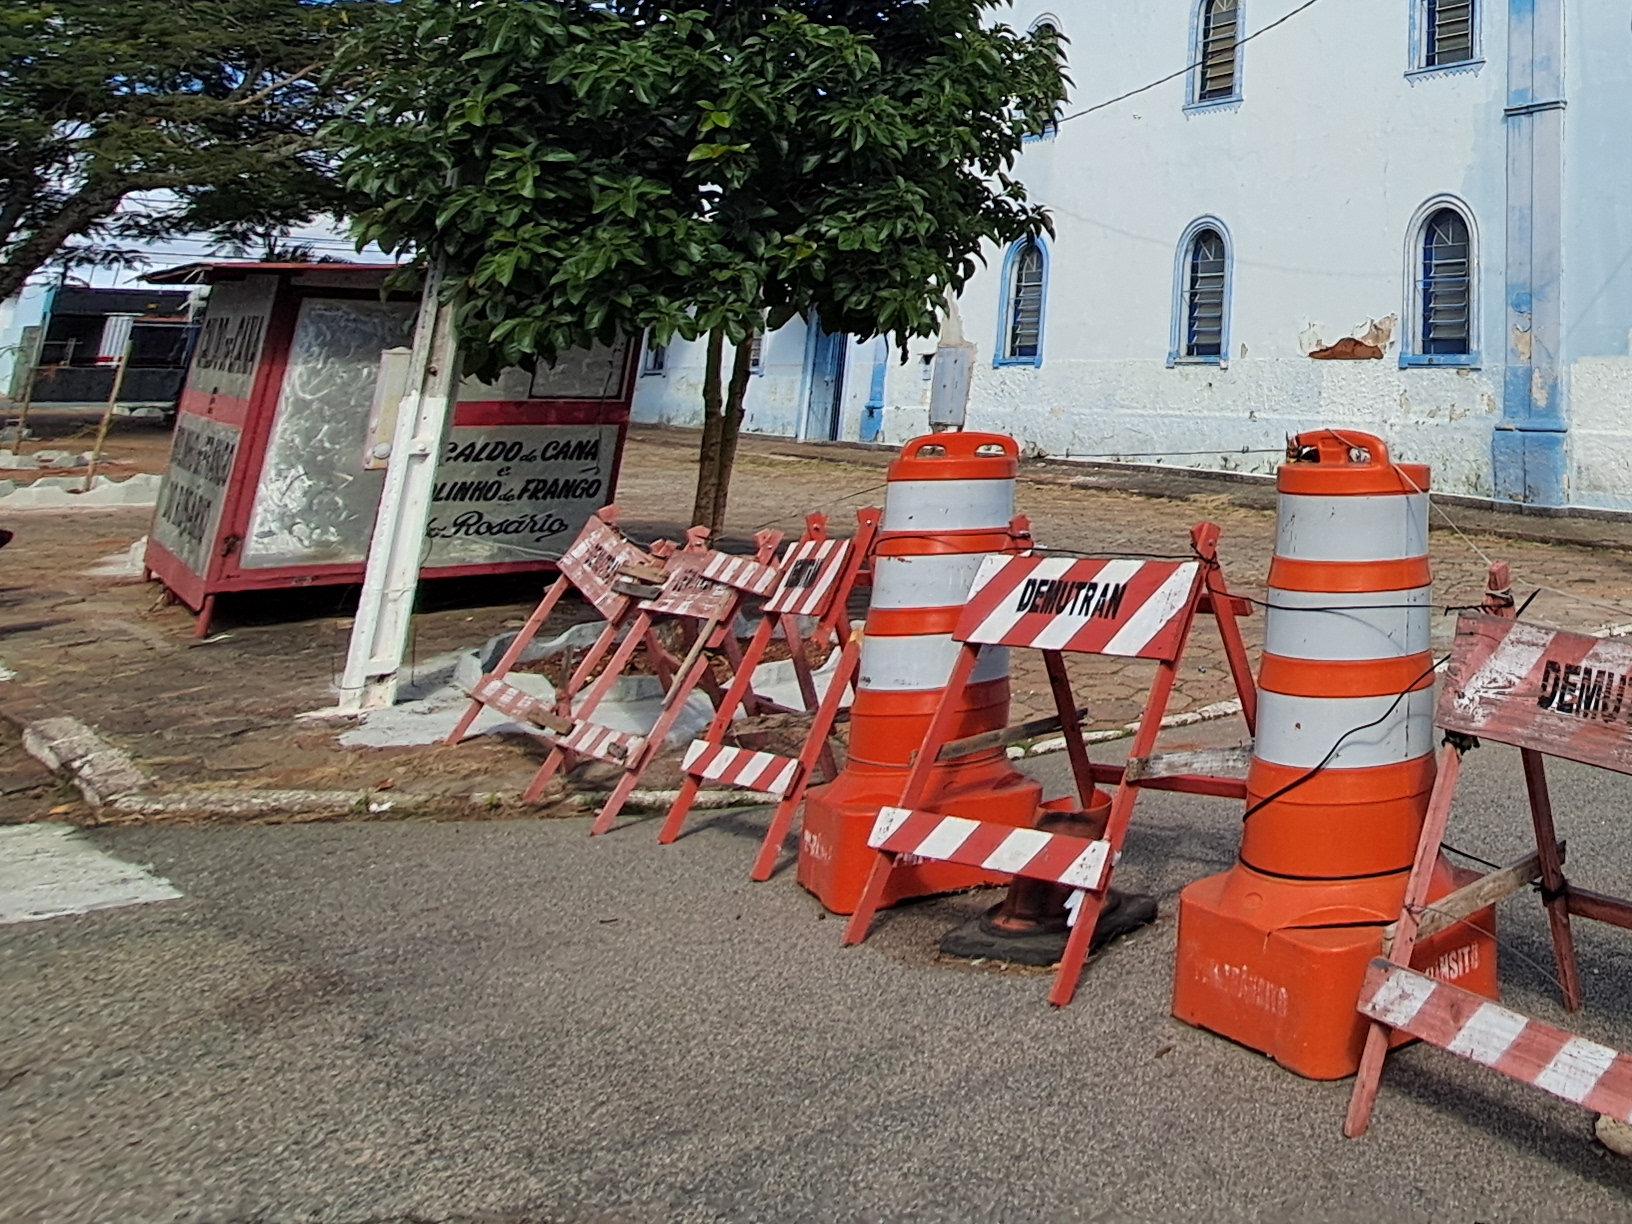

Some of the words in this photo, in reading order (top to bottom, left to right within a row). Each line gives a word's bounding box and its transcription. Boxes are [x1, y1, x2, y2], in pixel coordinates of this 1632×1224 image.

[540, 439, 600, 462] CANA
[433, 480, 502, 502] LINHO
[517, 478, 602, 501] FRANGO
[452, 510, 569, 543] Rosário
[1016, 578, 1129, 620] DEMUTRAN
